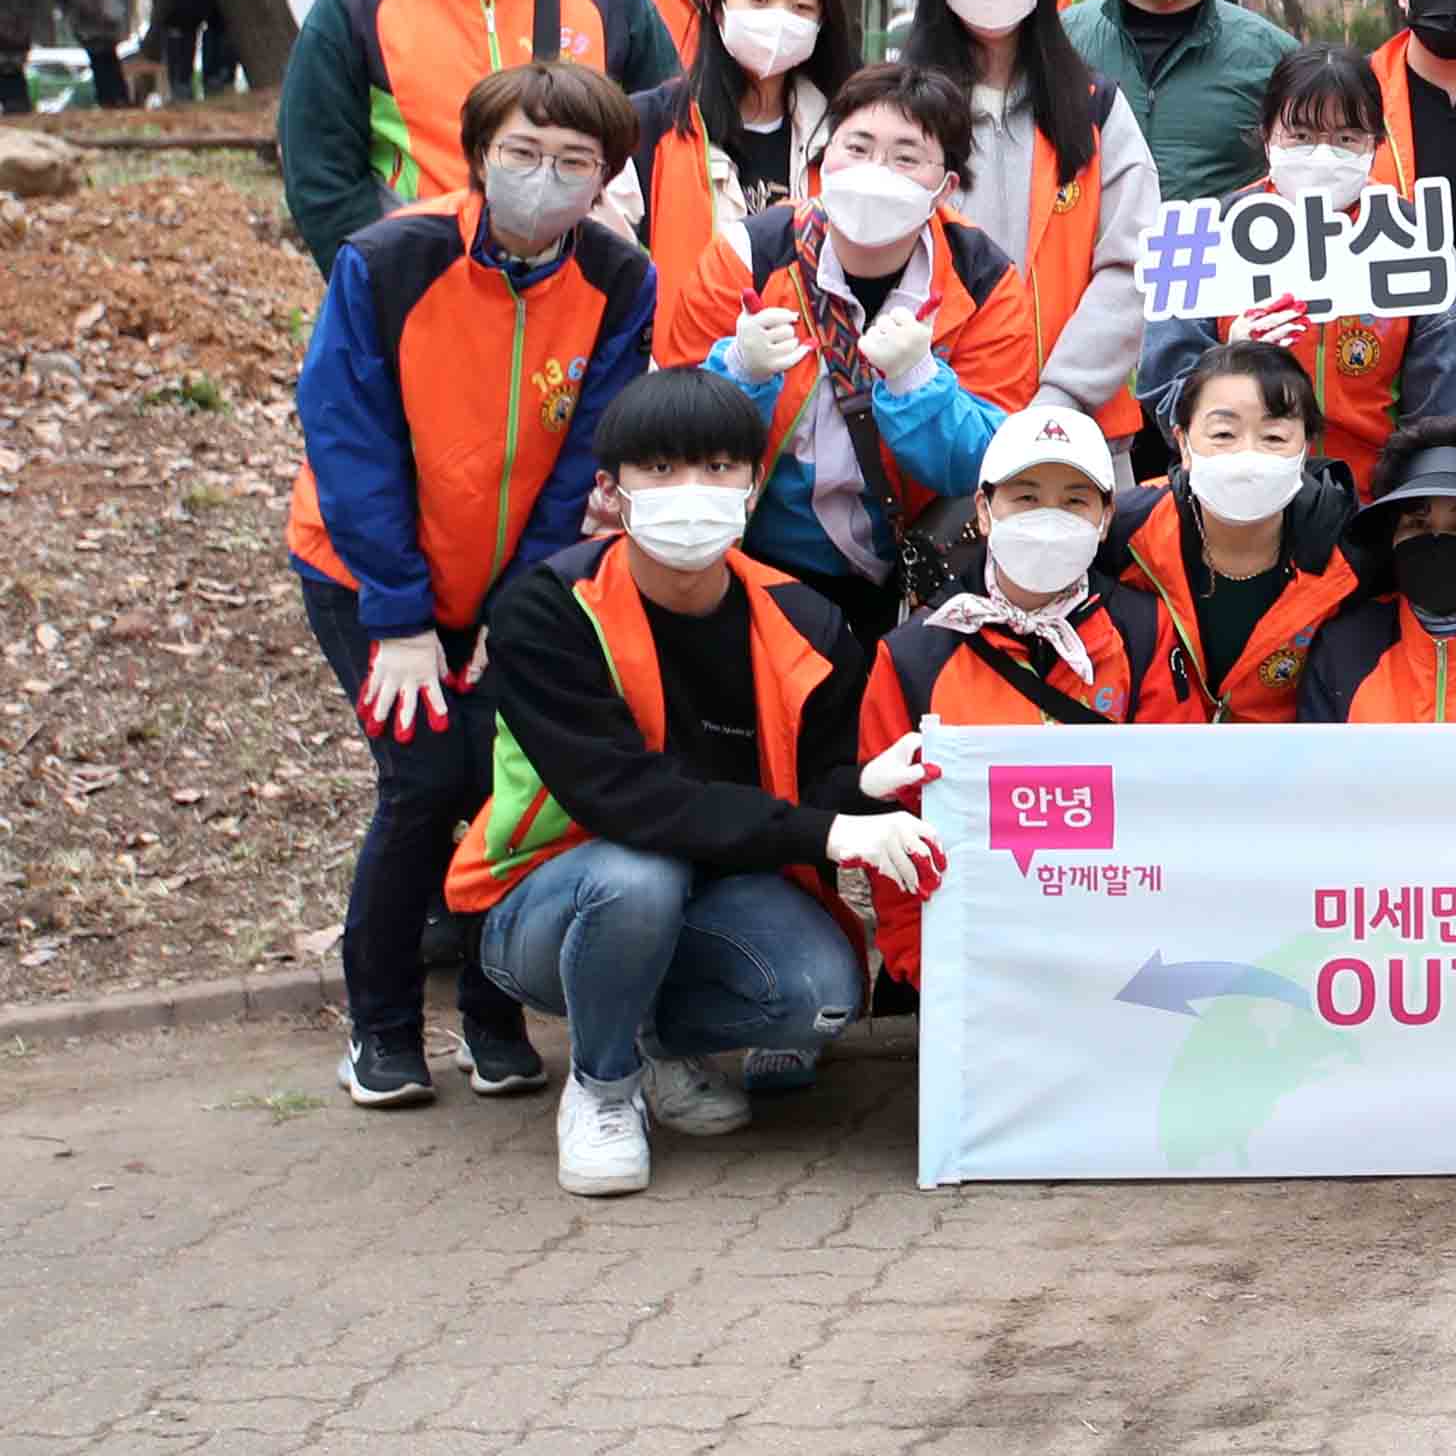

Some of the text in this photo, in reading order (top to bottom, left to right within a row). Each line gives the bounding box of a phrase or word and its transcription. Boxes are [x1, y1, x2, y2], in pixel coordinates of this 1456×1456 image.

[1143, 186, 1448, 314] #안심
[1010, 786, 1092, 828] 안녕
[1036, 865, 1162, 896] 함께할게
